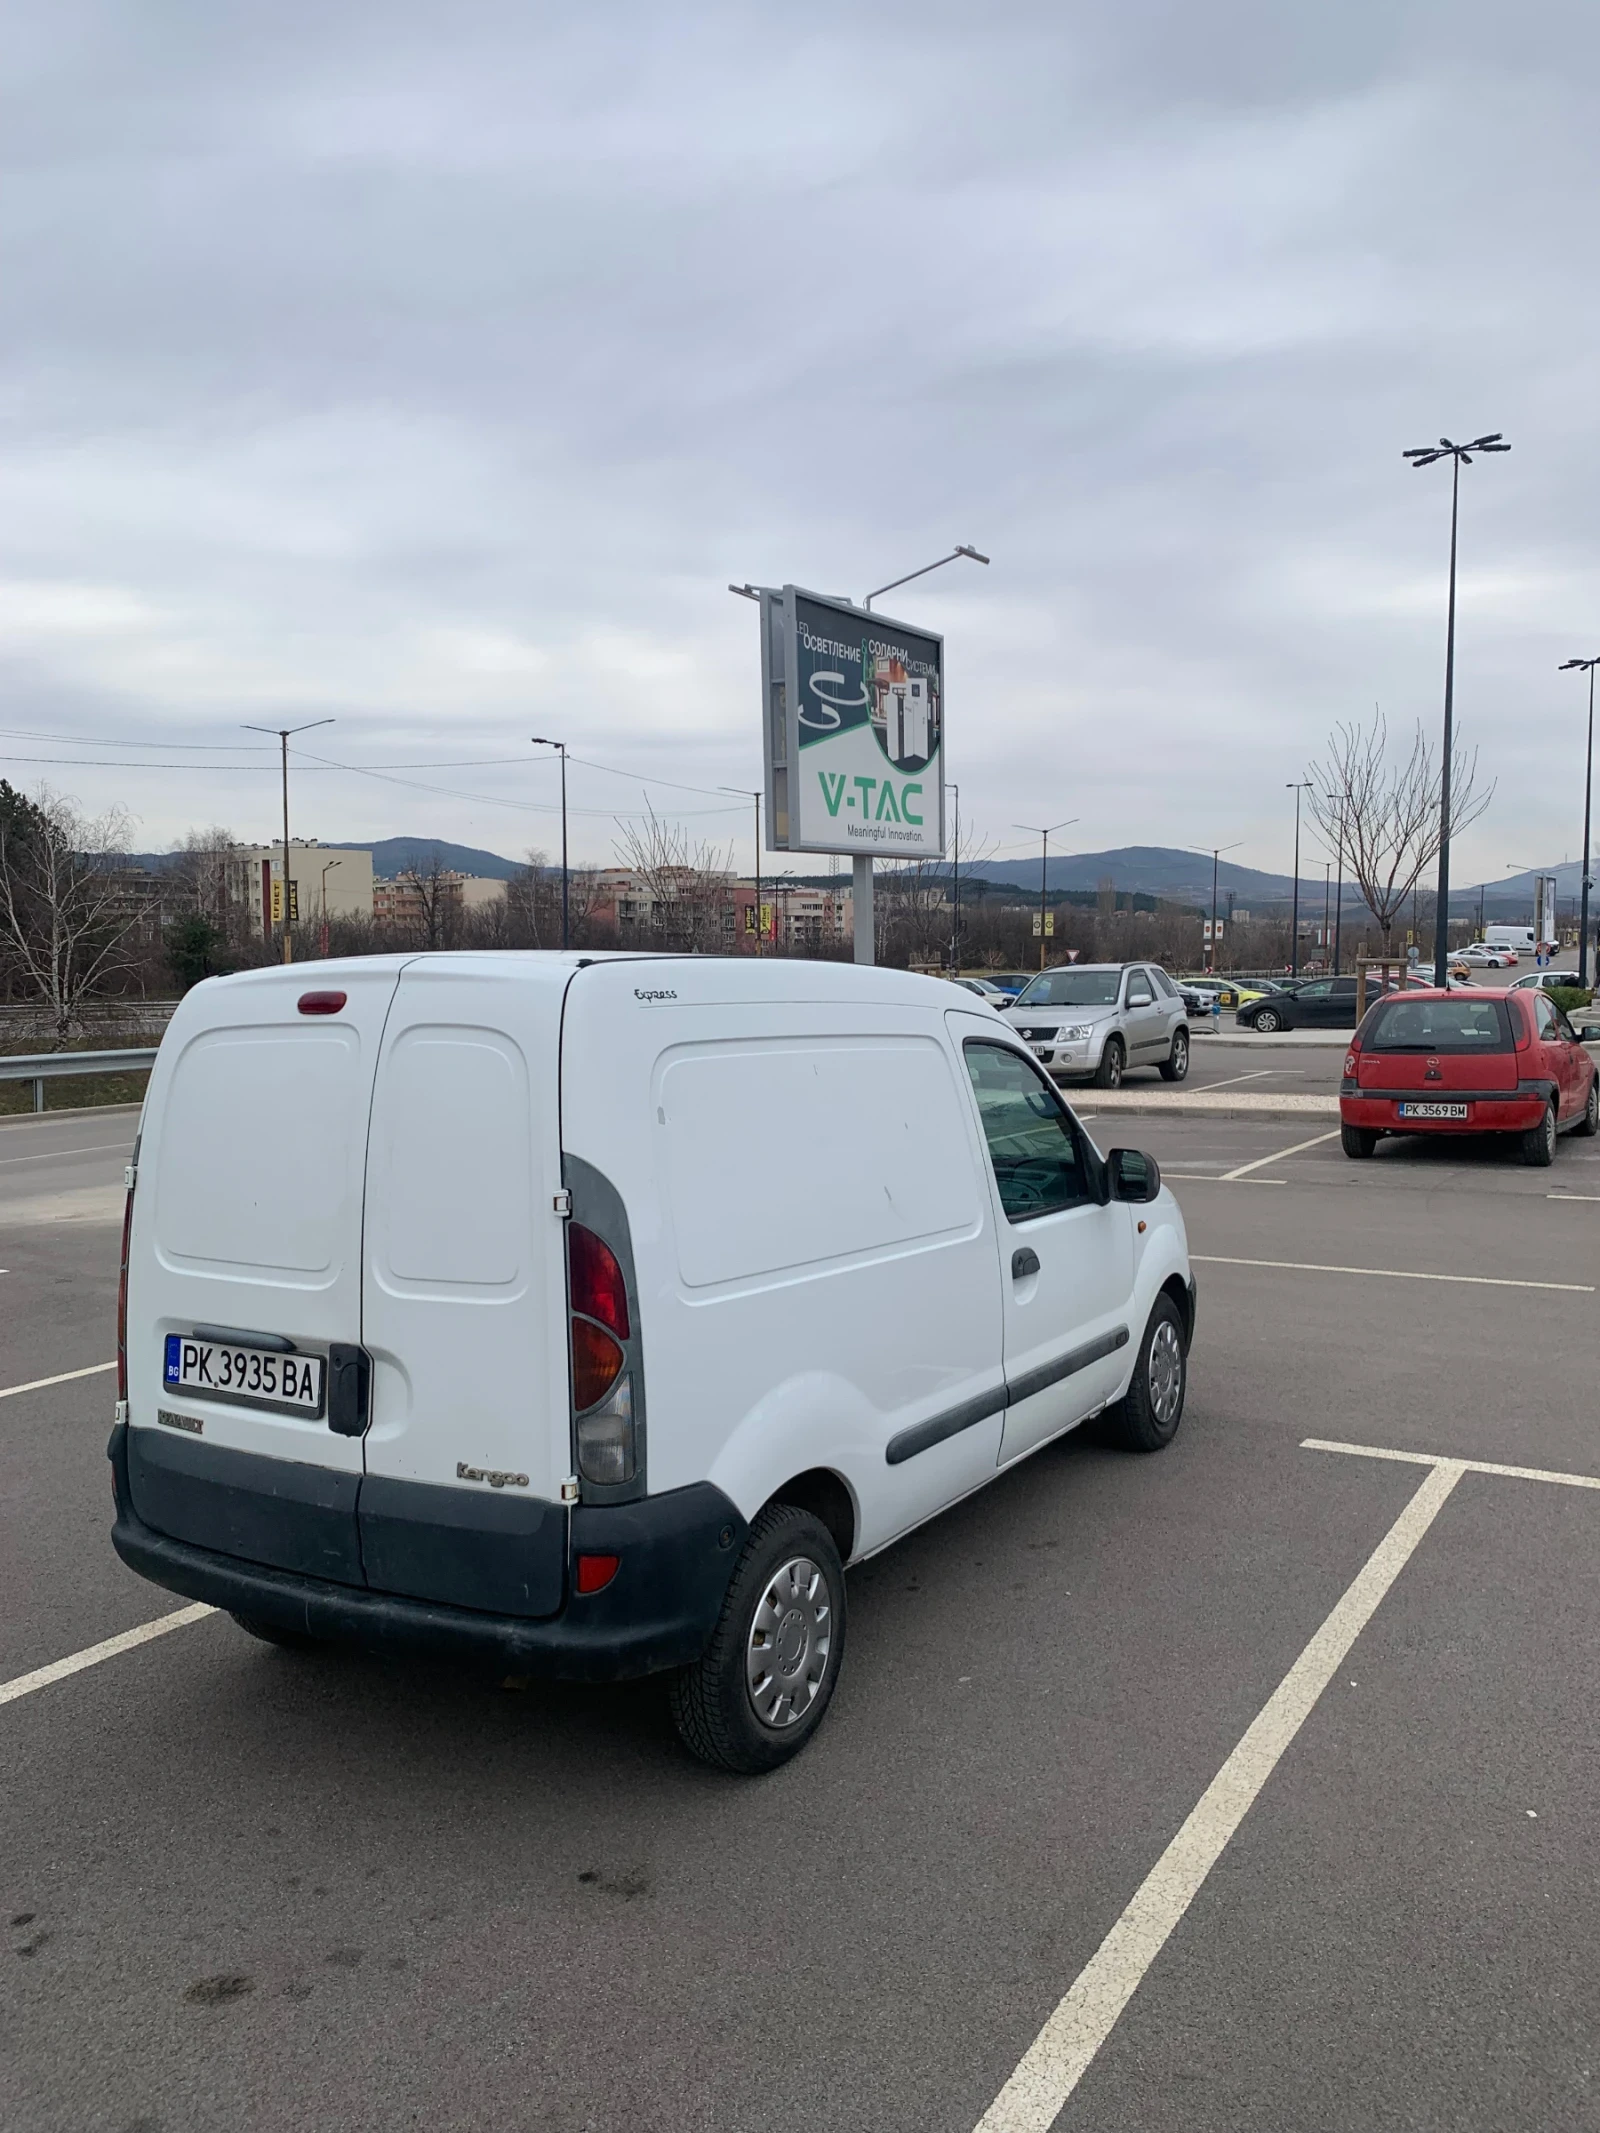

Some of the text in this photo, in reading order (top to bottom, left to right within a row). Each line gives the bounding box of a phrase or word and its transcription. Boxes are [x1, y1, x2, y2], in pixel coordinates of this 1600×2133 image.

[804, 634, 861, 663] ОСВЕТЛЕНИЕ
[868, 639, 908, 663] СОЛАРНИ
[818, 772, 923, 825] V-TAC
[847, 824, 886, 841] Meaningful
[634, 989, 677, 1003] Express
[1406, 1105, 1465, 1116] PK 3569 BM
[168, 1365, 179, 1377] BG
[182, 1344, 313, 1401] PK 3935 BA
